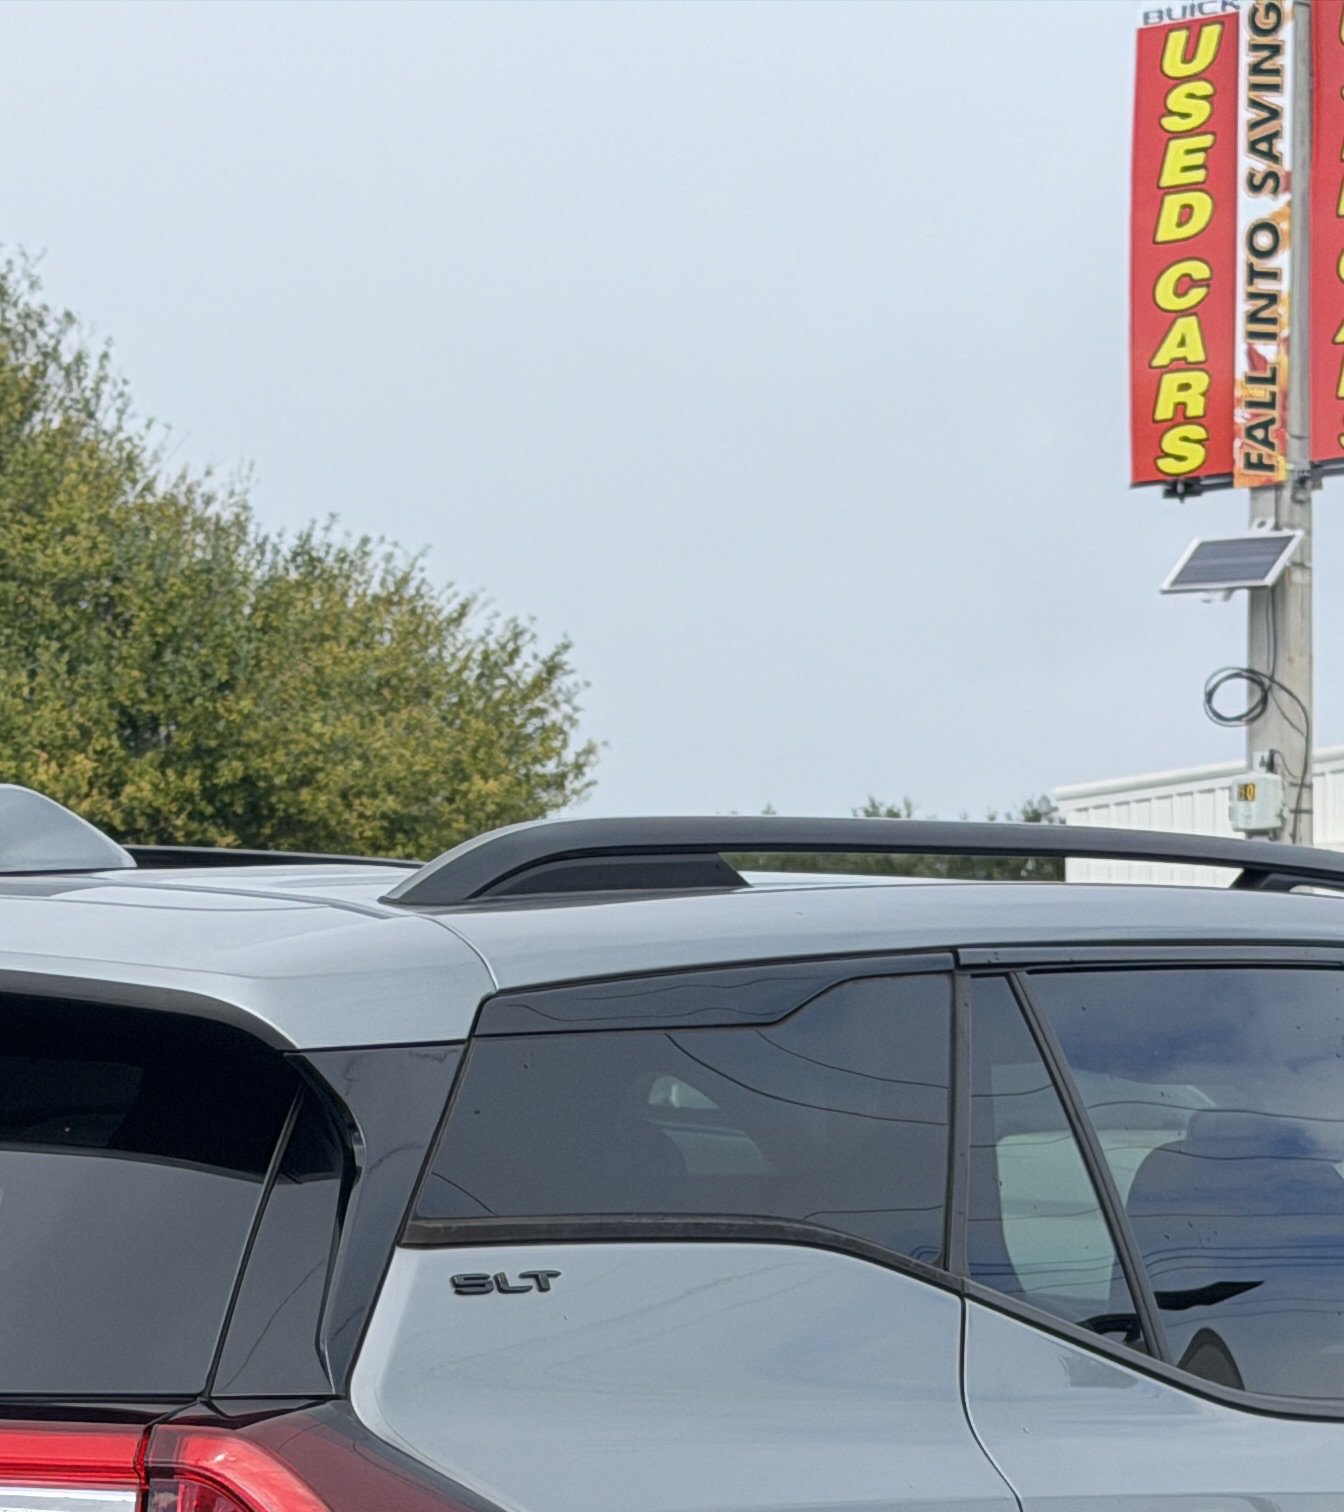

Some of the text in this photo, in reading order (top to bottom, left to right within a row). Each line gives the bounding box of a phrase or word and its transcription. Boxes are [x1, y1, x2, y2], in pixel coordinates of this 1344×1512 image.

[1150, 22, 1224, 477] USED CARS
[1244, 0, 1283, 474] FALL INTO SAVING
[450, 1270, 562, 1296] SLT
